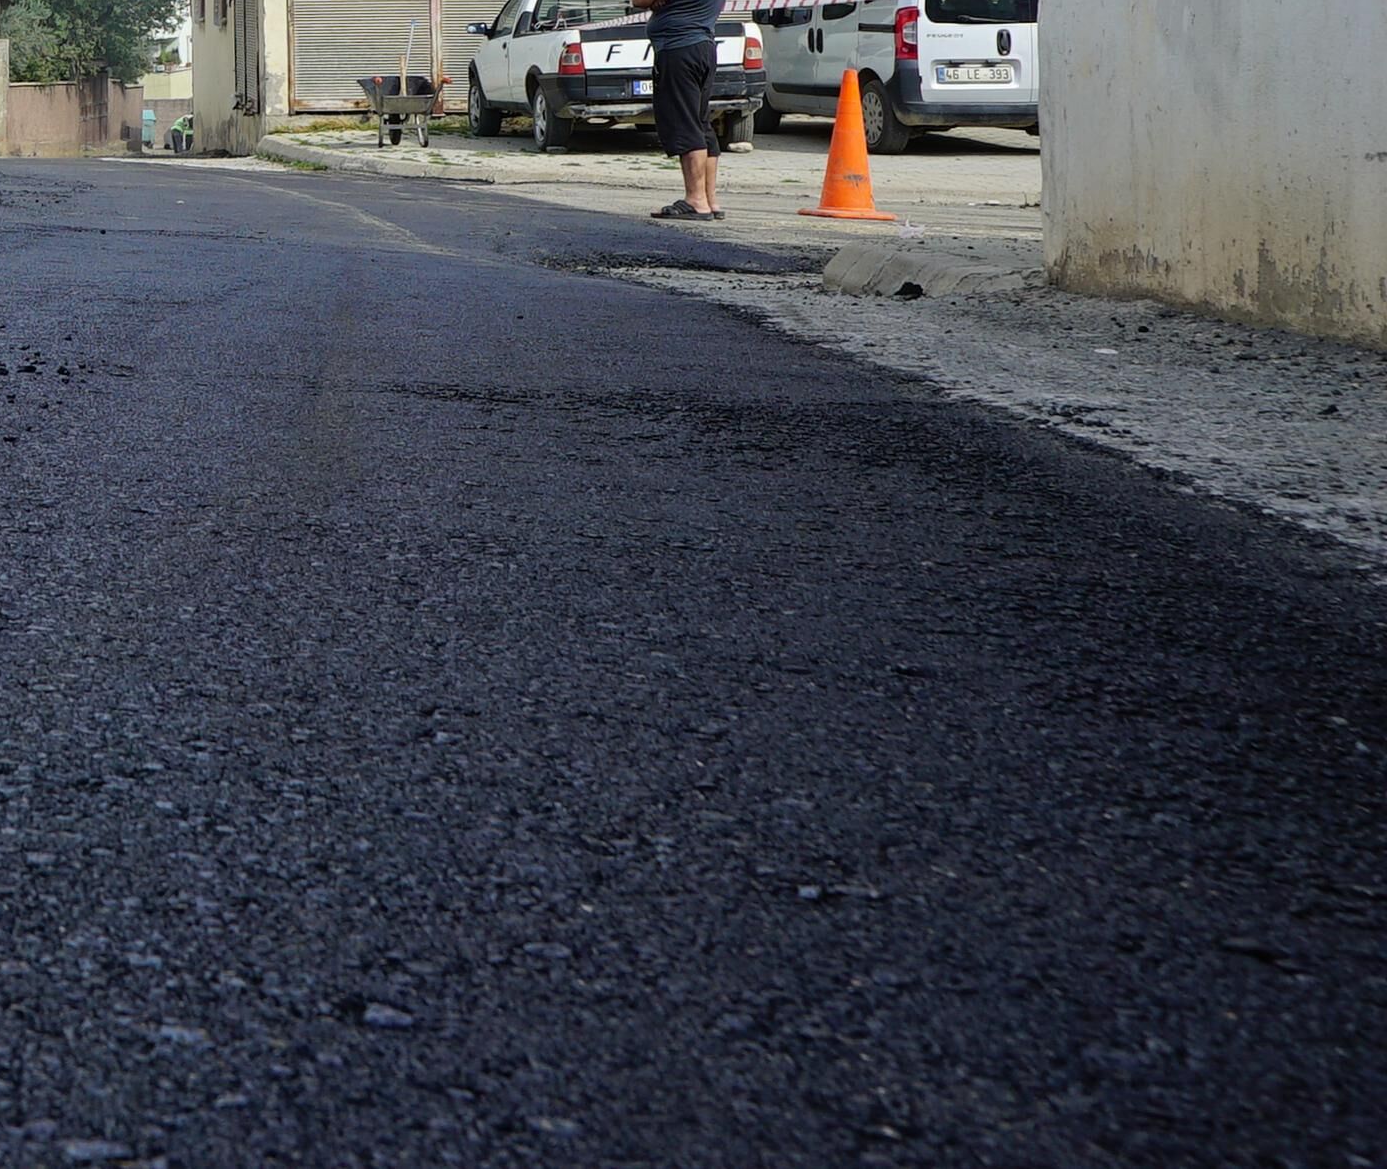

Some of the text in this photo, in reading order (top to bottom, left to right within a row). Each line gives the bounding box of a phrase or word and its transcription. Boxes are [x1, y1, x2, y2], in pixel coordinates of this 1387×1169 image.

[946, 68, 1009, 80] 46 LE 393
